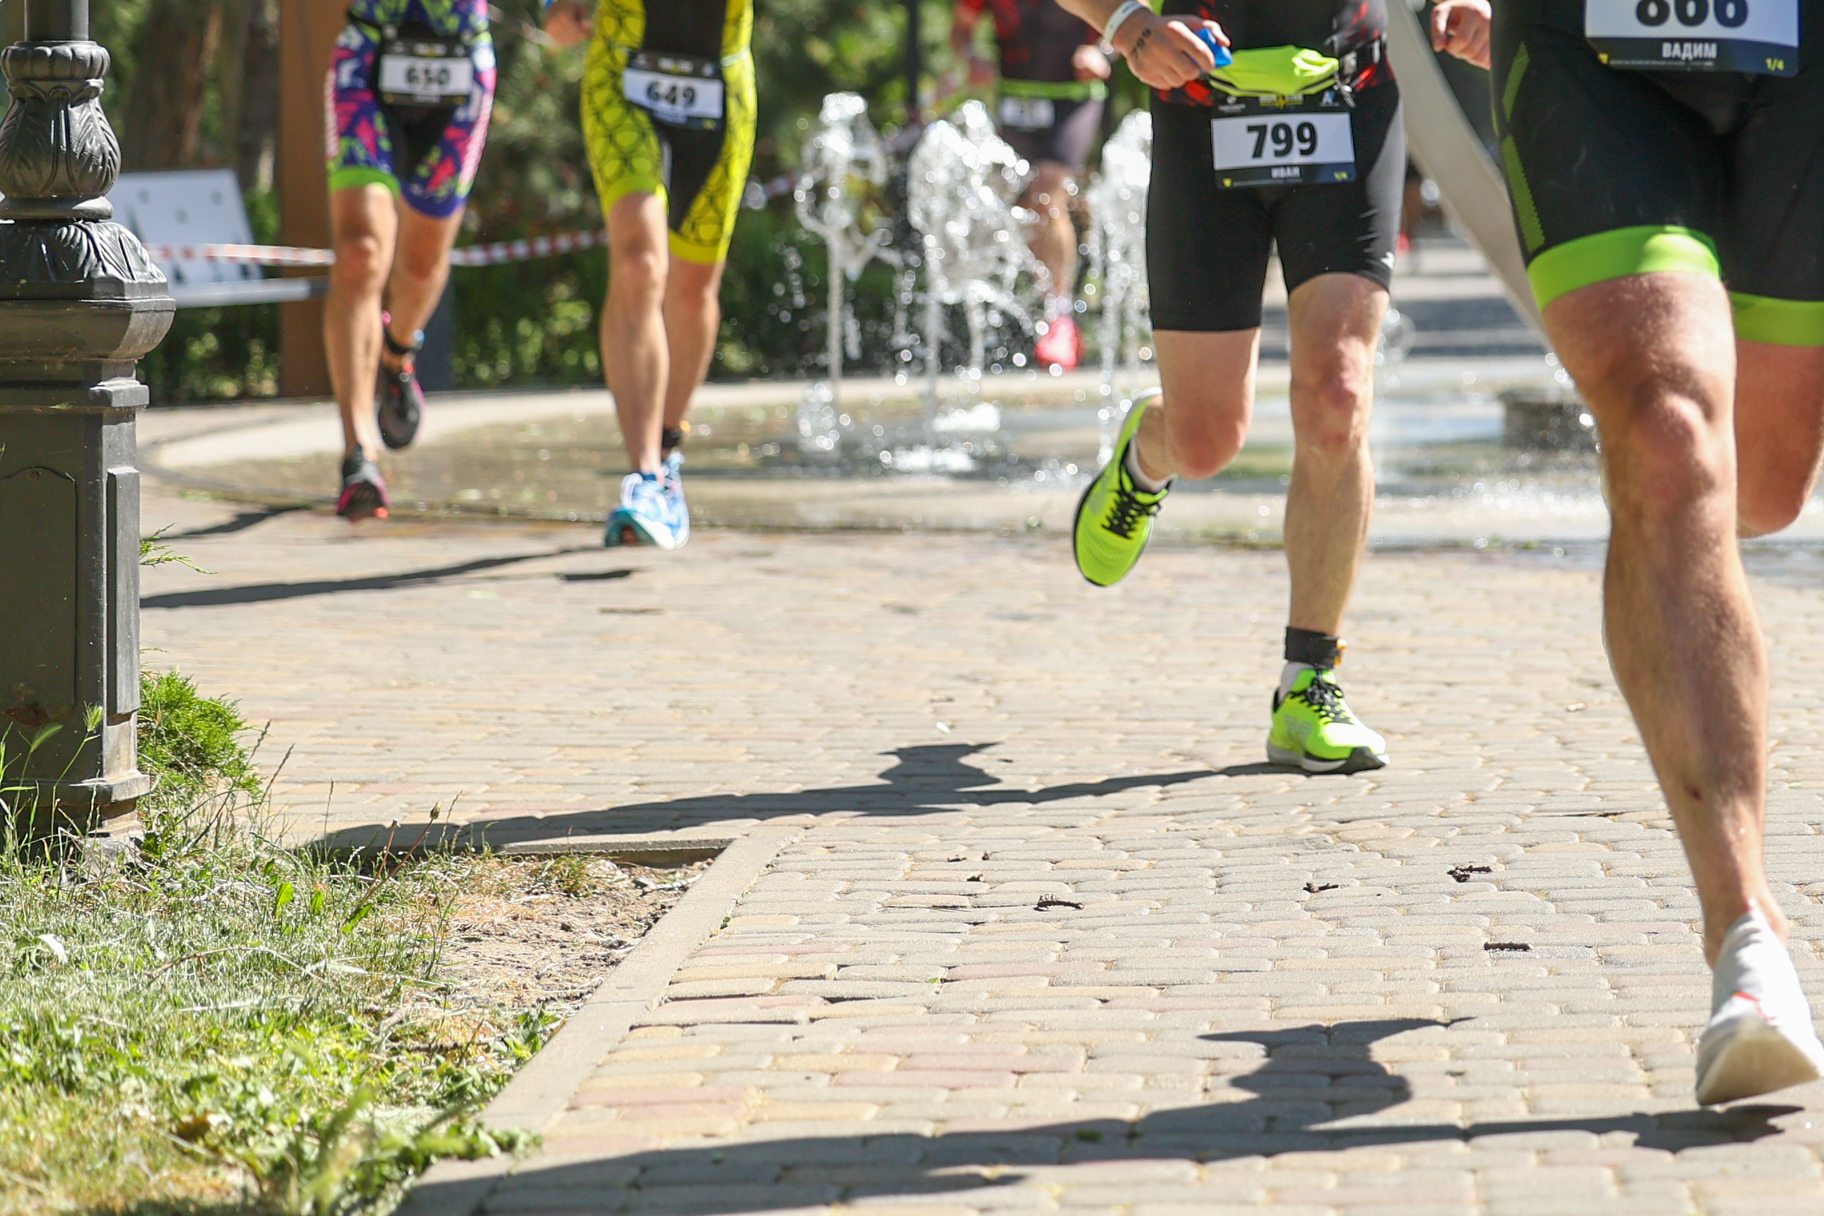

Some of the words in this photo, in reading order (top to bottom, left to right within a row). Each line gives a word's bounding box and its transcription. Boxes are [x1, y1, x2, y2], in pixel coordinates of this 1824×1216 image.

[1661, 42, 1718, 60] ВАДИМ
[1765, 57, 1785, 71] 1/4
[646, 81, 696, 109] 649
[1247, 121, 1319, 159] 799
